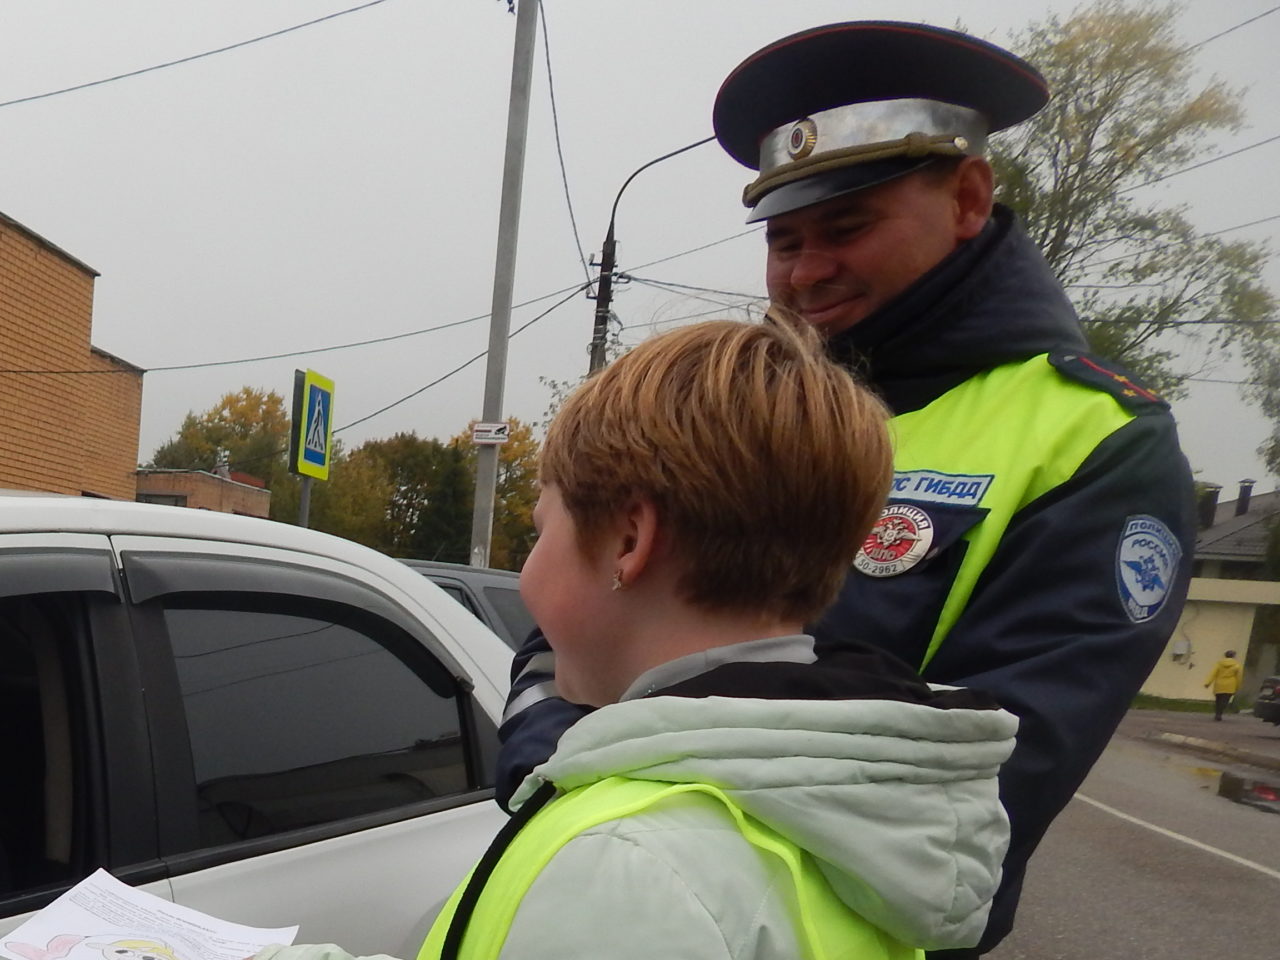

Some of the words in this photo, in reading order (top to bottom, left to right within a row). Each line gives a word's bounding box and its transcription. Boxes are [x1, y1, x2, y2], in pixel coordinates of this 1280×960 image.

[914, 477, 982, 499] ГИБДД
[881, 505, 929, 529] ОЛИЦИЯ
[870, 548, 896, 561] ДПС
